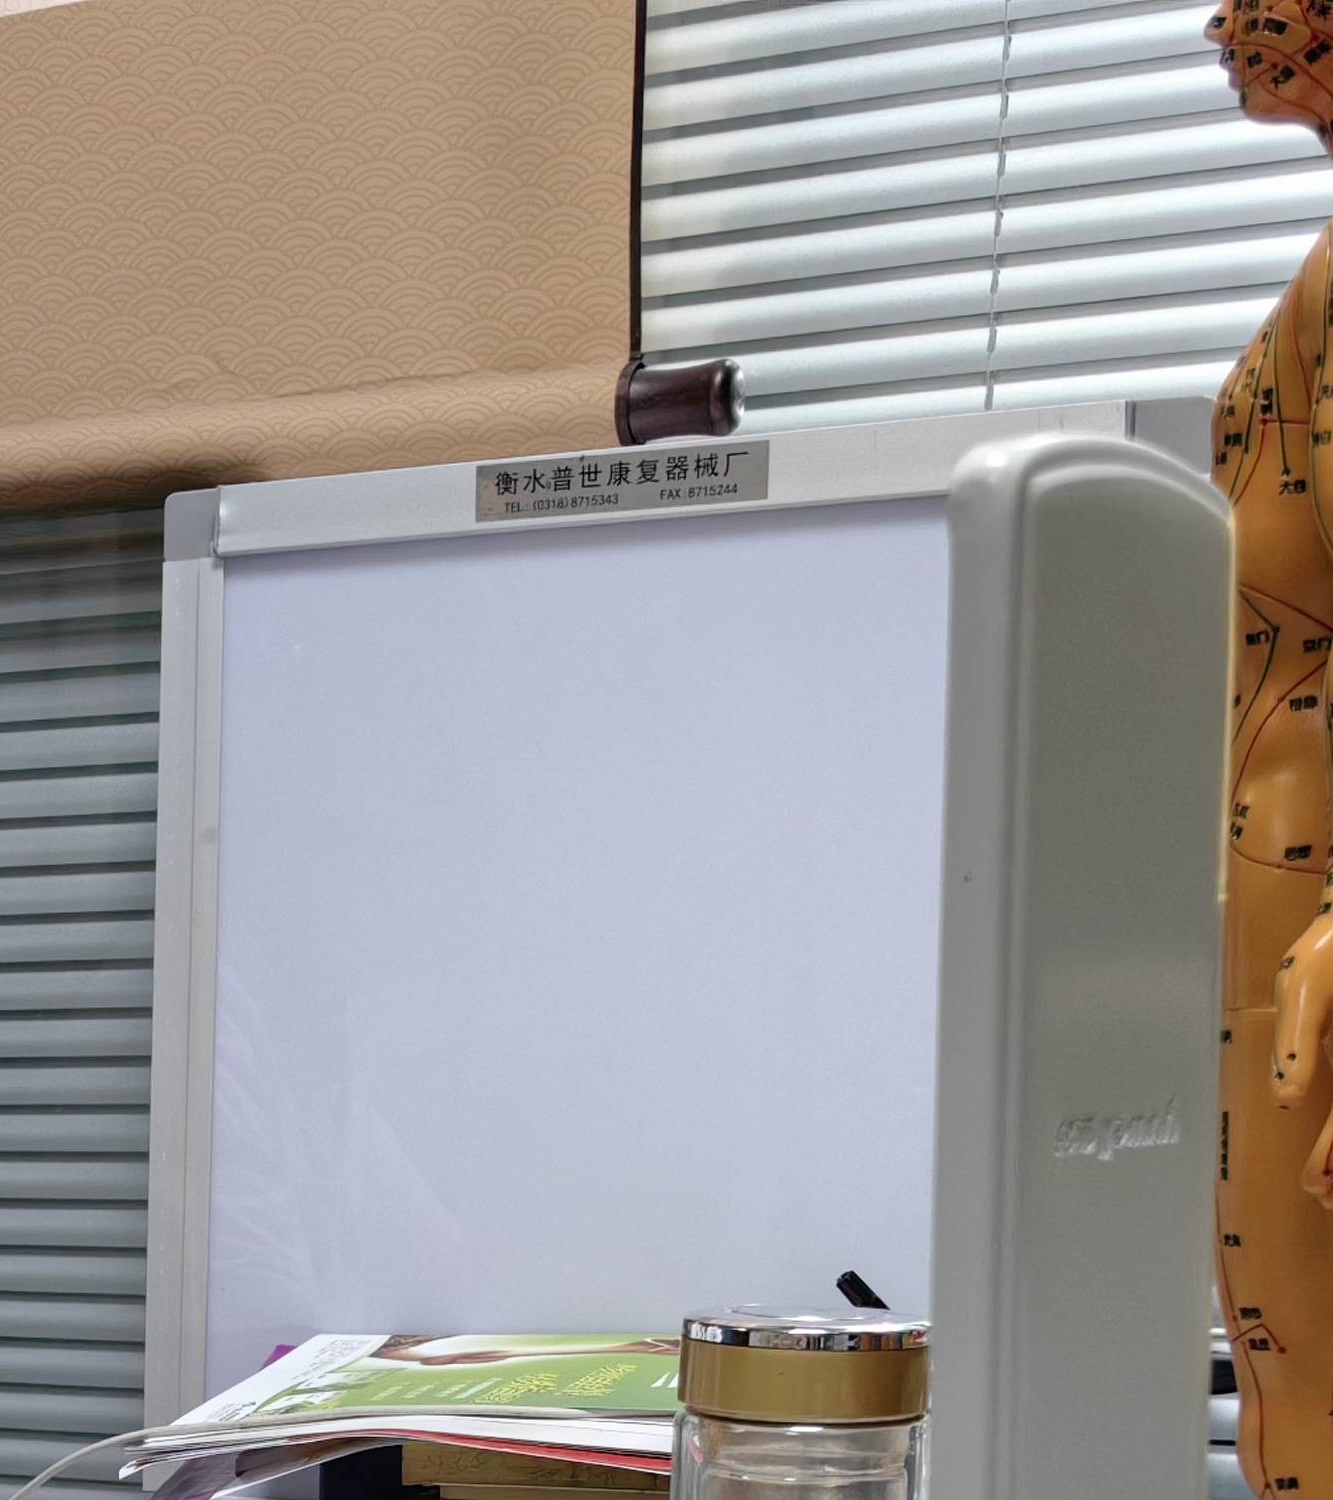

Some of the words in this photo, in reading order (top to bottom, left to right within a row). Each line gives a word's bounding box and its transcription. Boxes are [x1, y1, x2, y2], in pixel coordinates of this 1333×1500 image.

[494, 451, 749, 496] 衡水普世康复器械厂
